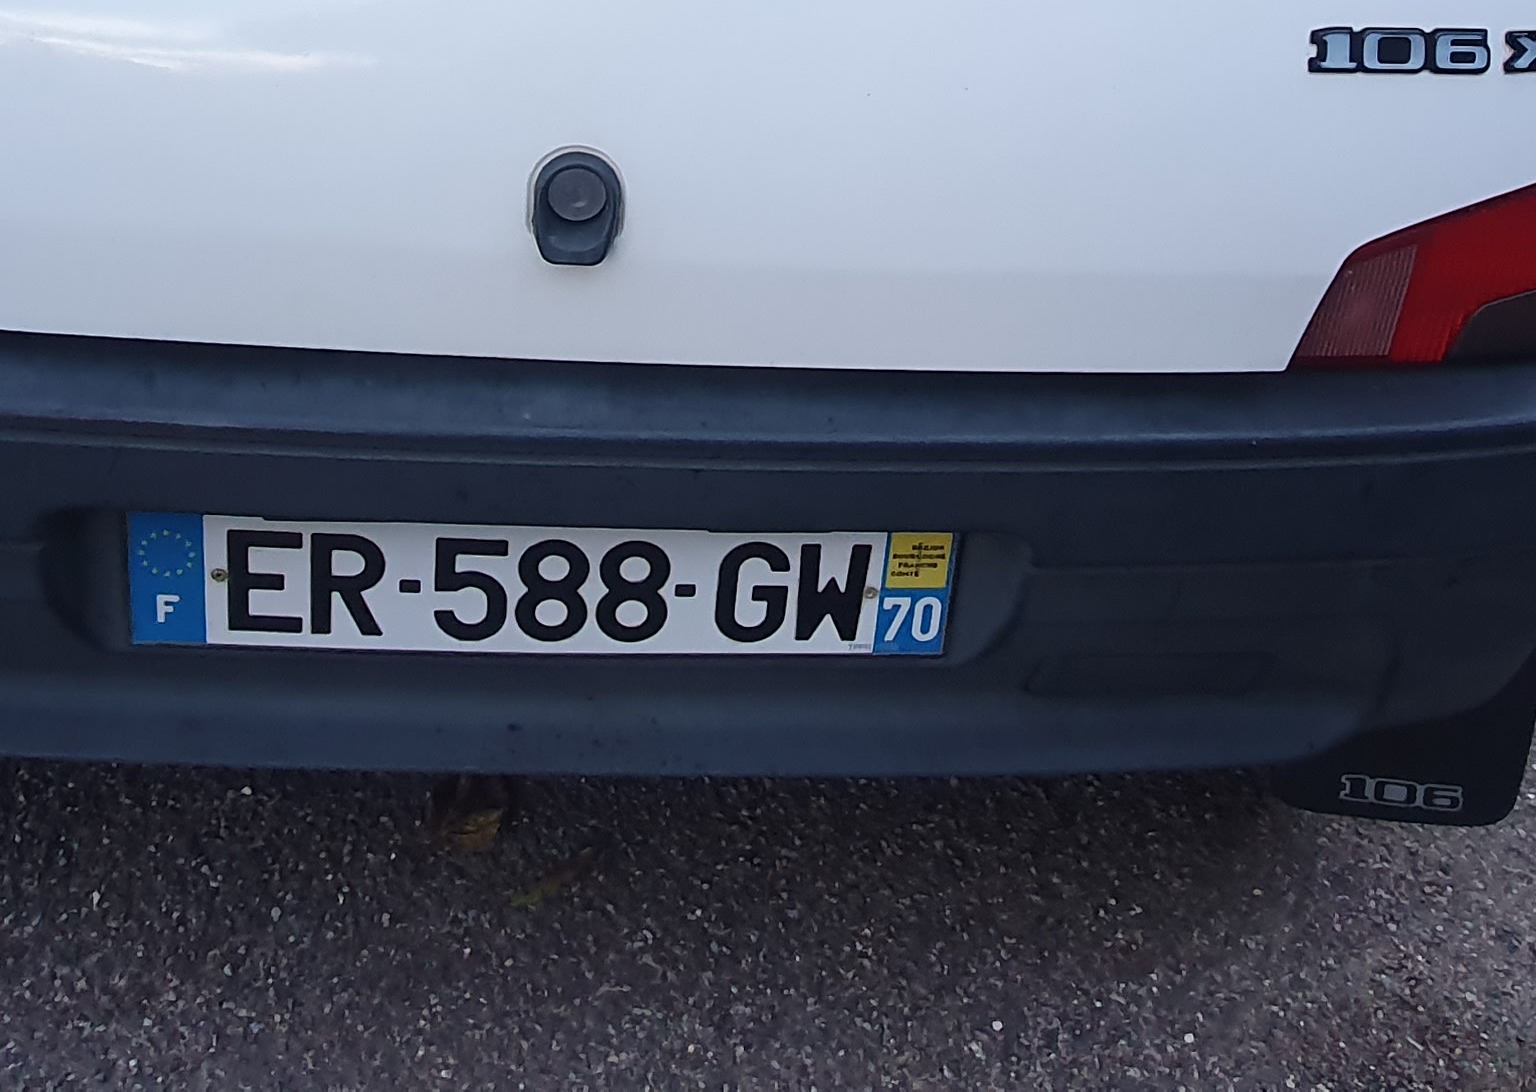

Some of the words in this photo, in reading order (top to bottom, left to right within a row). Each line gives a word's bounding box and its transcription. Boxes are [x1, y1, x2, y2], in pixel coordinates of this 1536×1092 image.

[1314, 29, 1490, 72] 106
[226, 528, 873, 643] ER-588-GW
[156, 594, 180, 623] F
[883, 596, 942, 642] 70
[1339, 774, 1464, 812] 106
